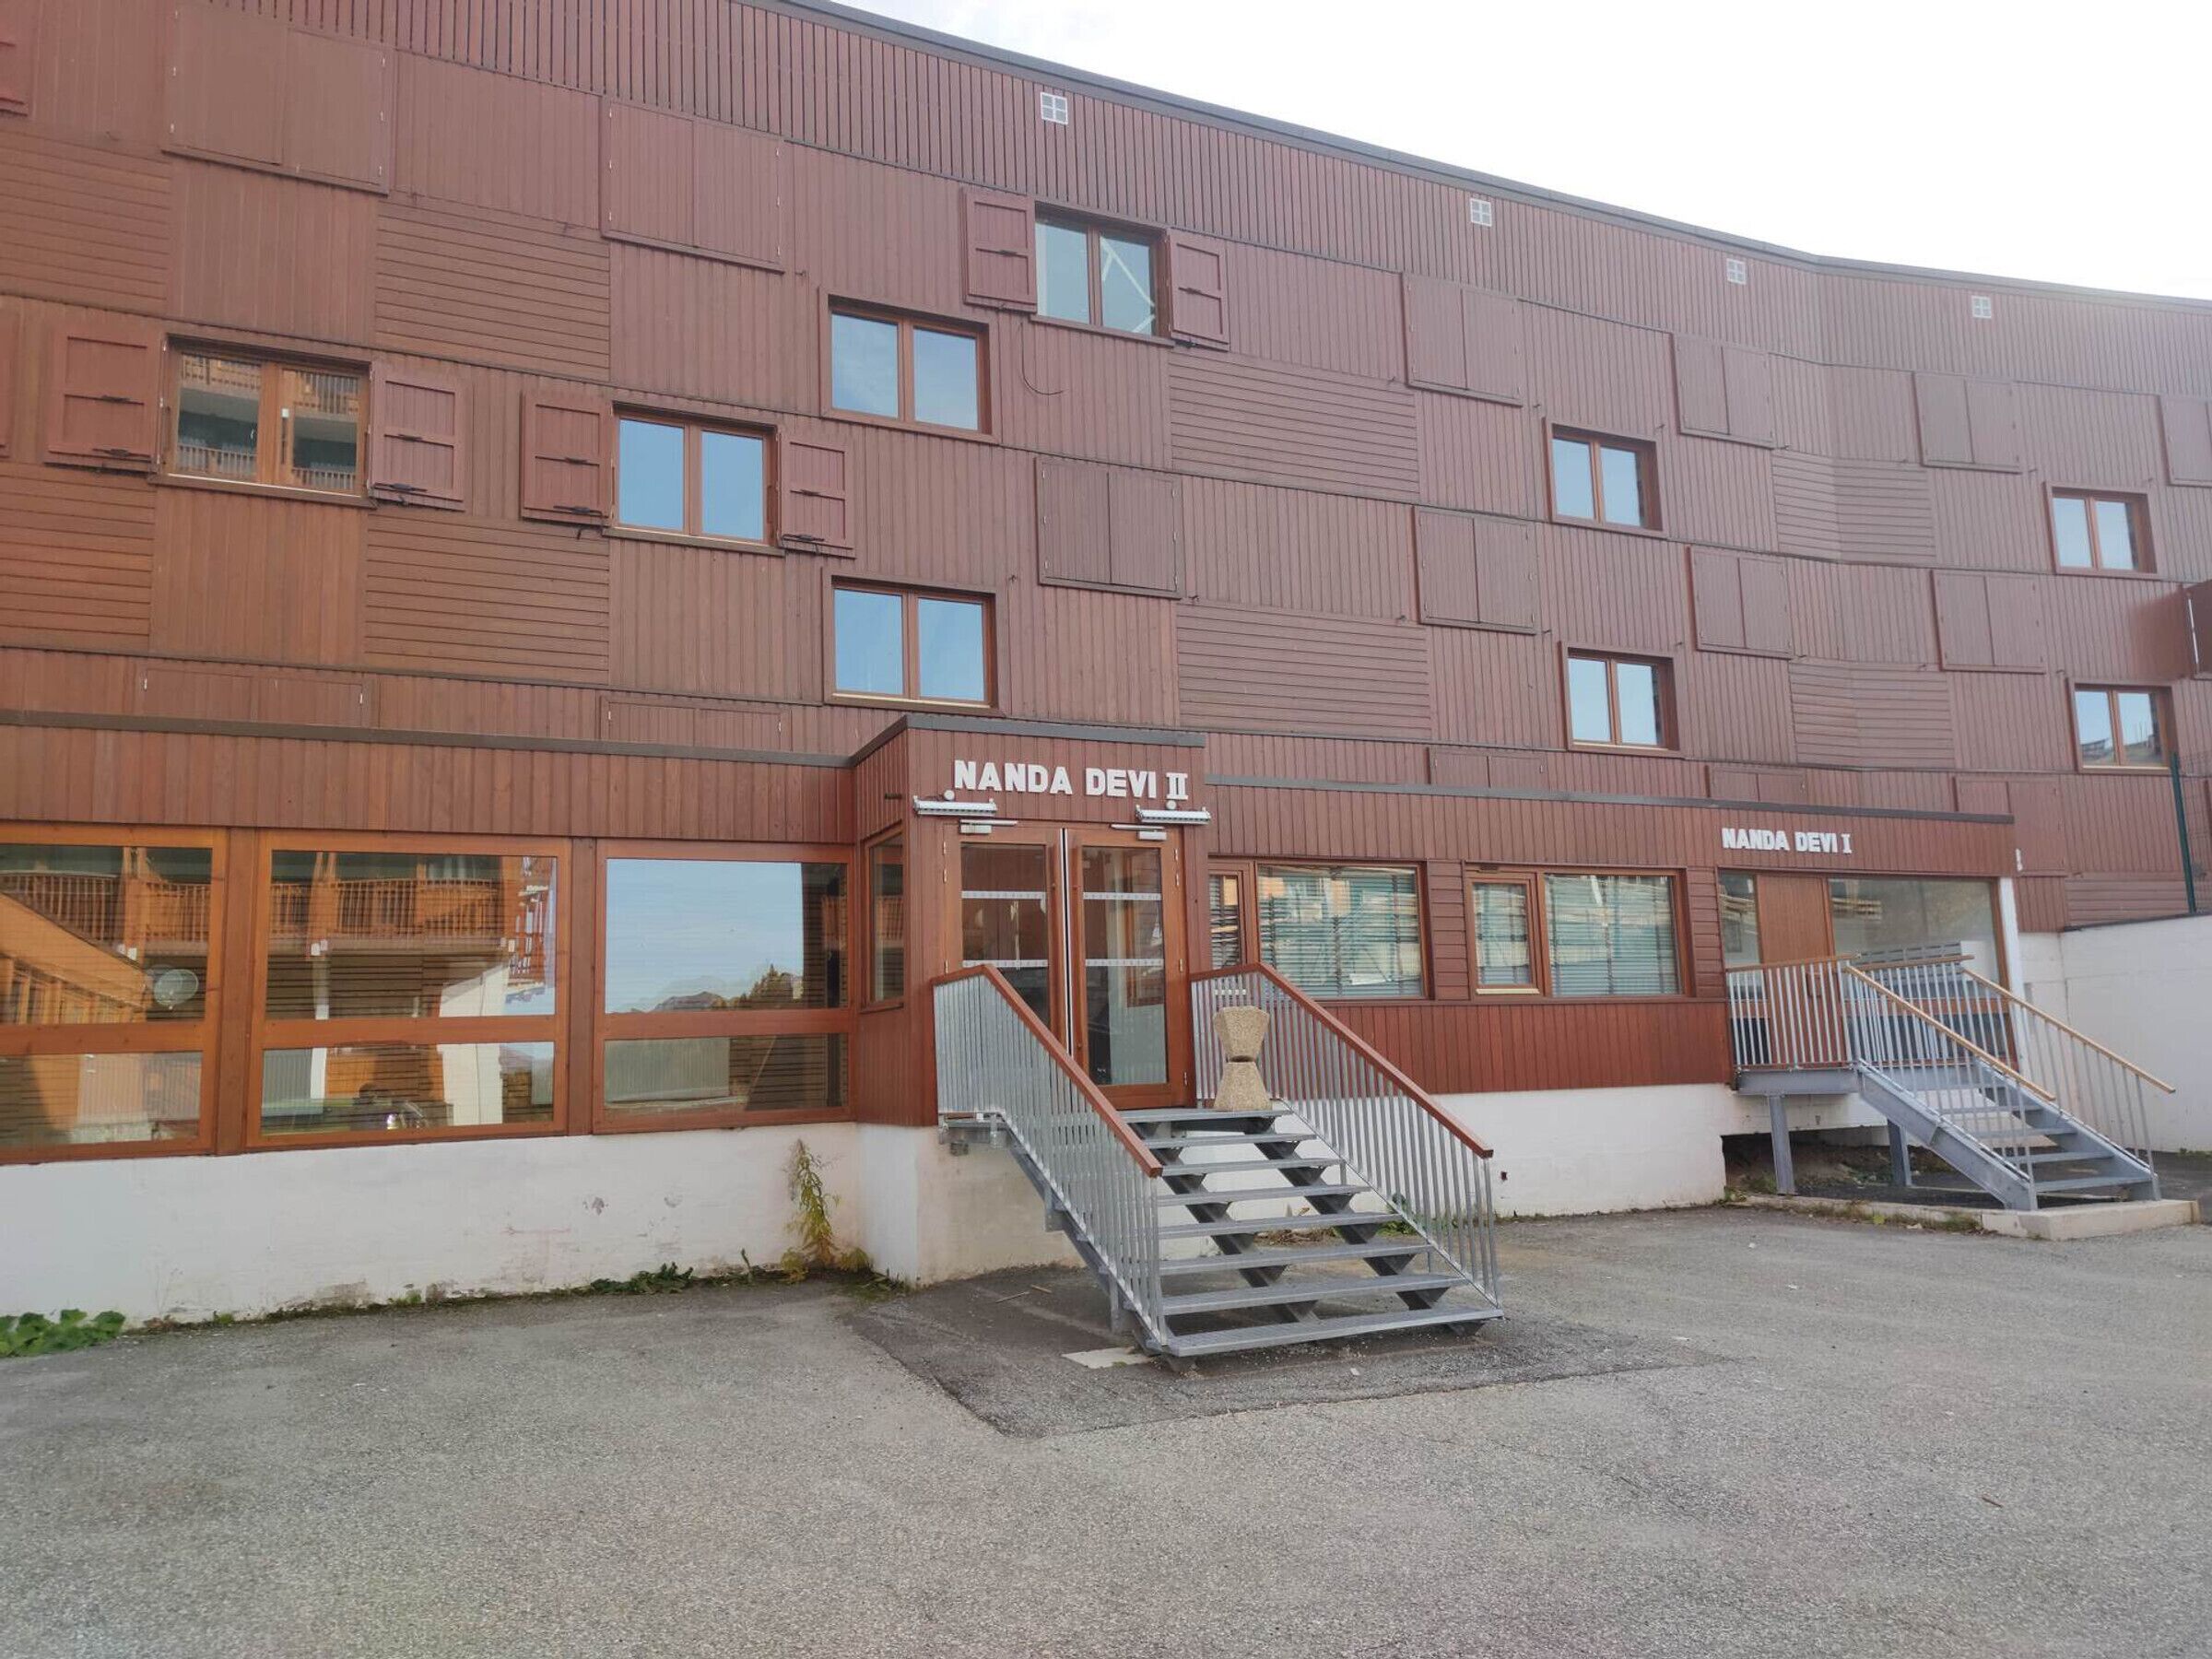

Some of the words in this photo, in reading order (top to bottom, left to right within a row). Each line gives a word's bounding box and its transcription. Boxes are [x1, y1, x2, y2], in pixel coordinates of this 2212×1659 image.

[954, 759, 1073, 794] NANDA
[1085, 768, 1157, 798] DEVI
[1166, 772, 1189, 800] II
[1722, 828, 1790, 851] NANDA
[1795, 831, 1838, 853] DEVI
[1841, 833, 1853, 853] I
